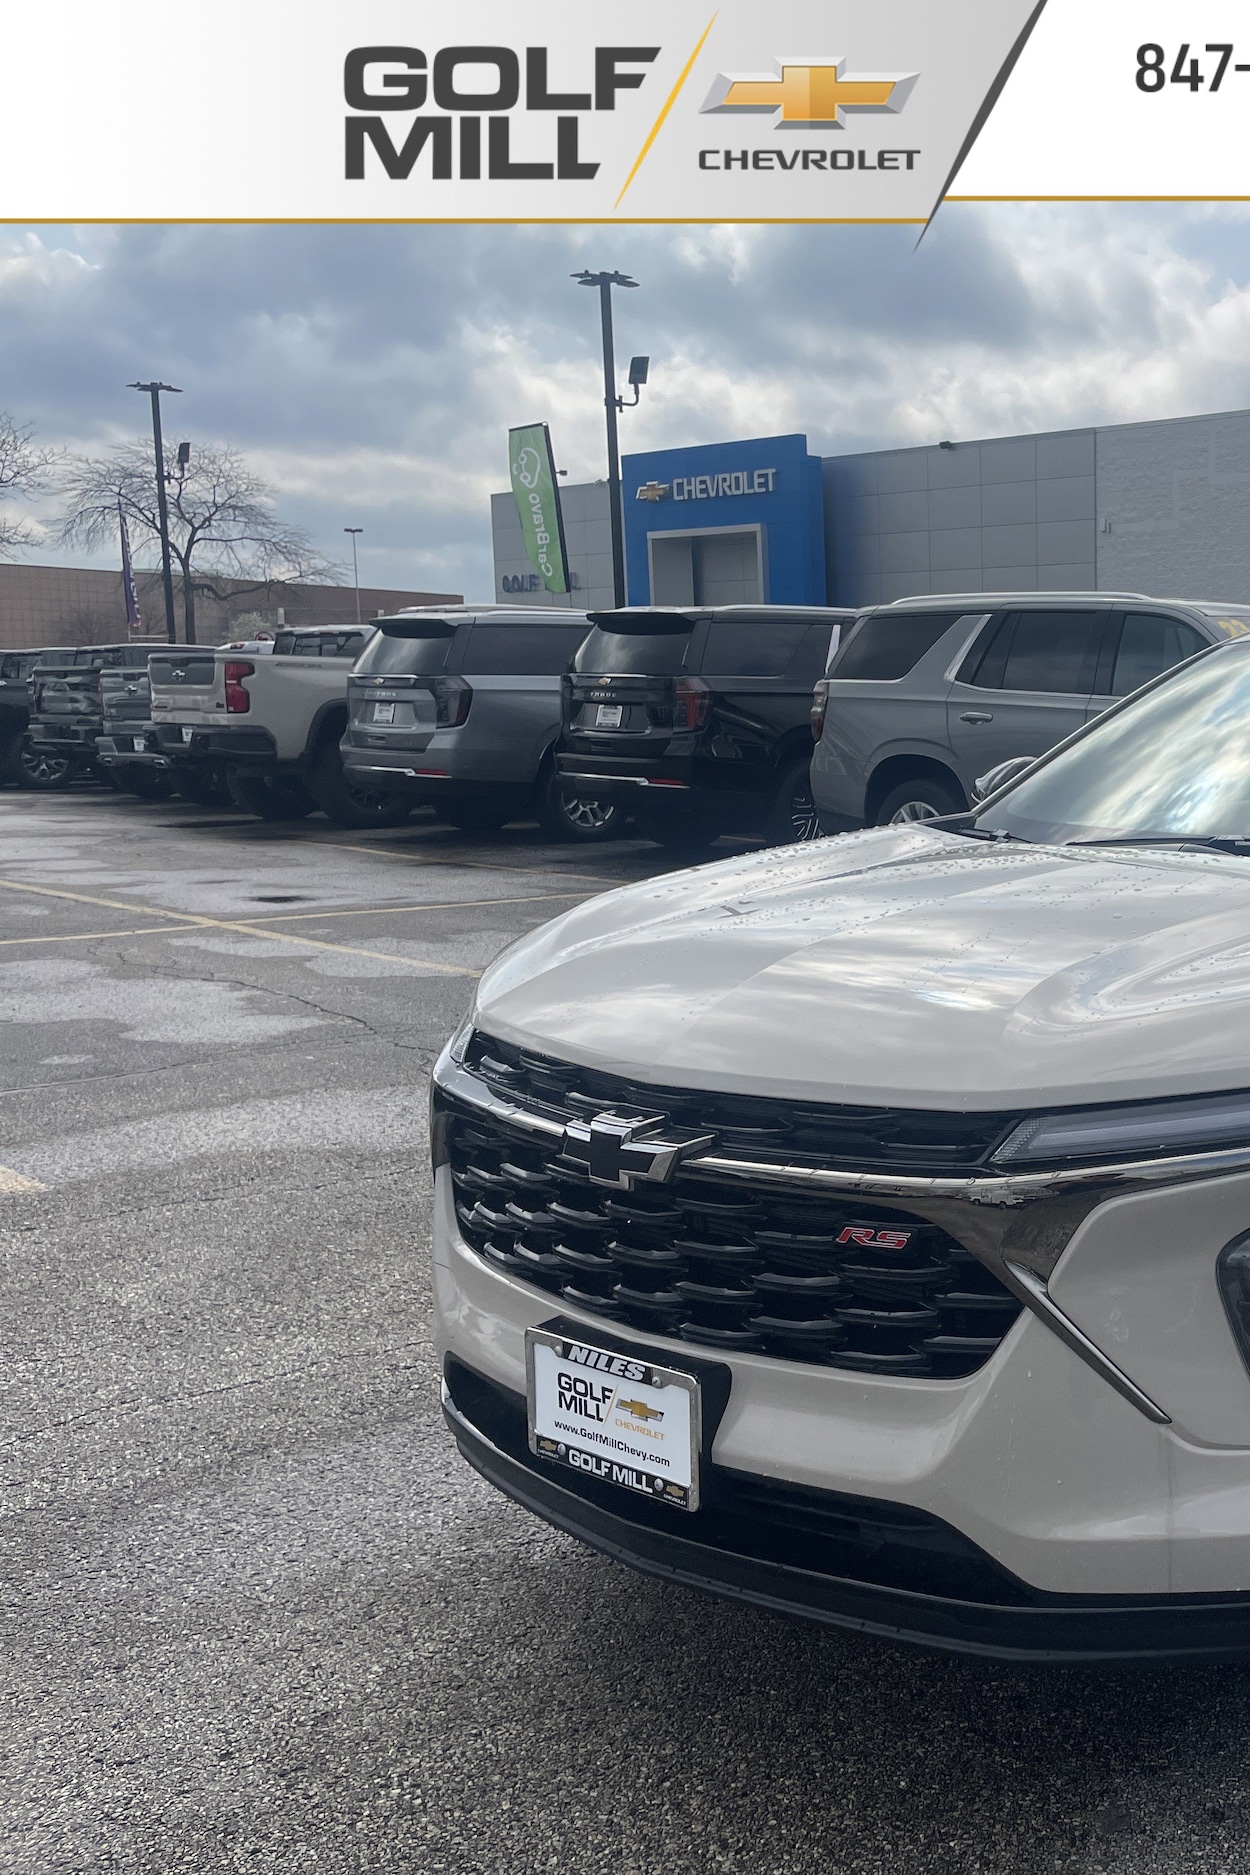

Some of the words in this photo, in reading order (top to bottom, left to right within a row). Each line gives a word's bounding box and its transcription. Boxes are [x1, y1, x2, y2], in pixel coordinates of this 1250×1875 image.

[672, 468, 778, 501] CHEVROLET
[836, 1226, 911, 1250] RS
[568, 1345, 646, 1381] NILES
[557, 1372, 614, 1404] GOLF
[558, 1390, 604, 1422] MILL
[554, 1420, 670, 1467] www.GolfMillChevy.com
[615, 1418, 665, 1441] CHEVROLET
[568, 1449, 611, 1477] GOLF
[612, 1464, 653, 1493] MILL
